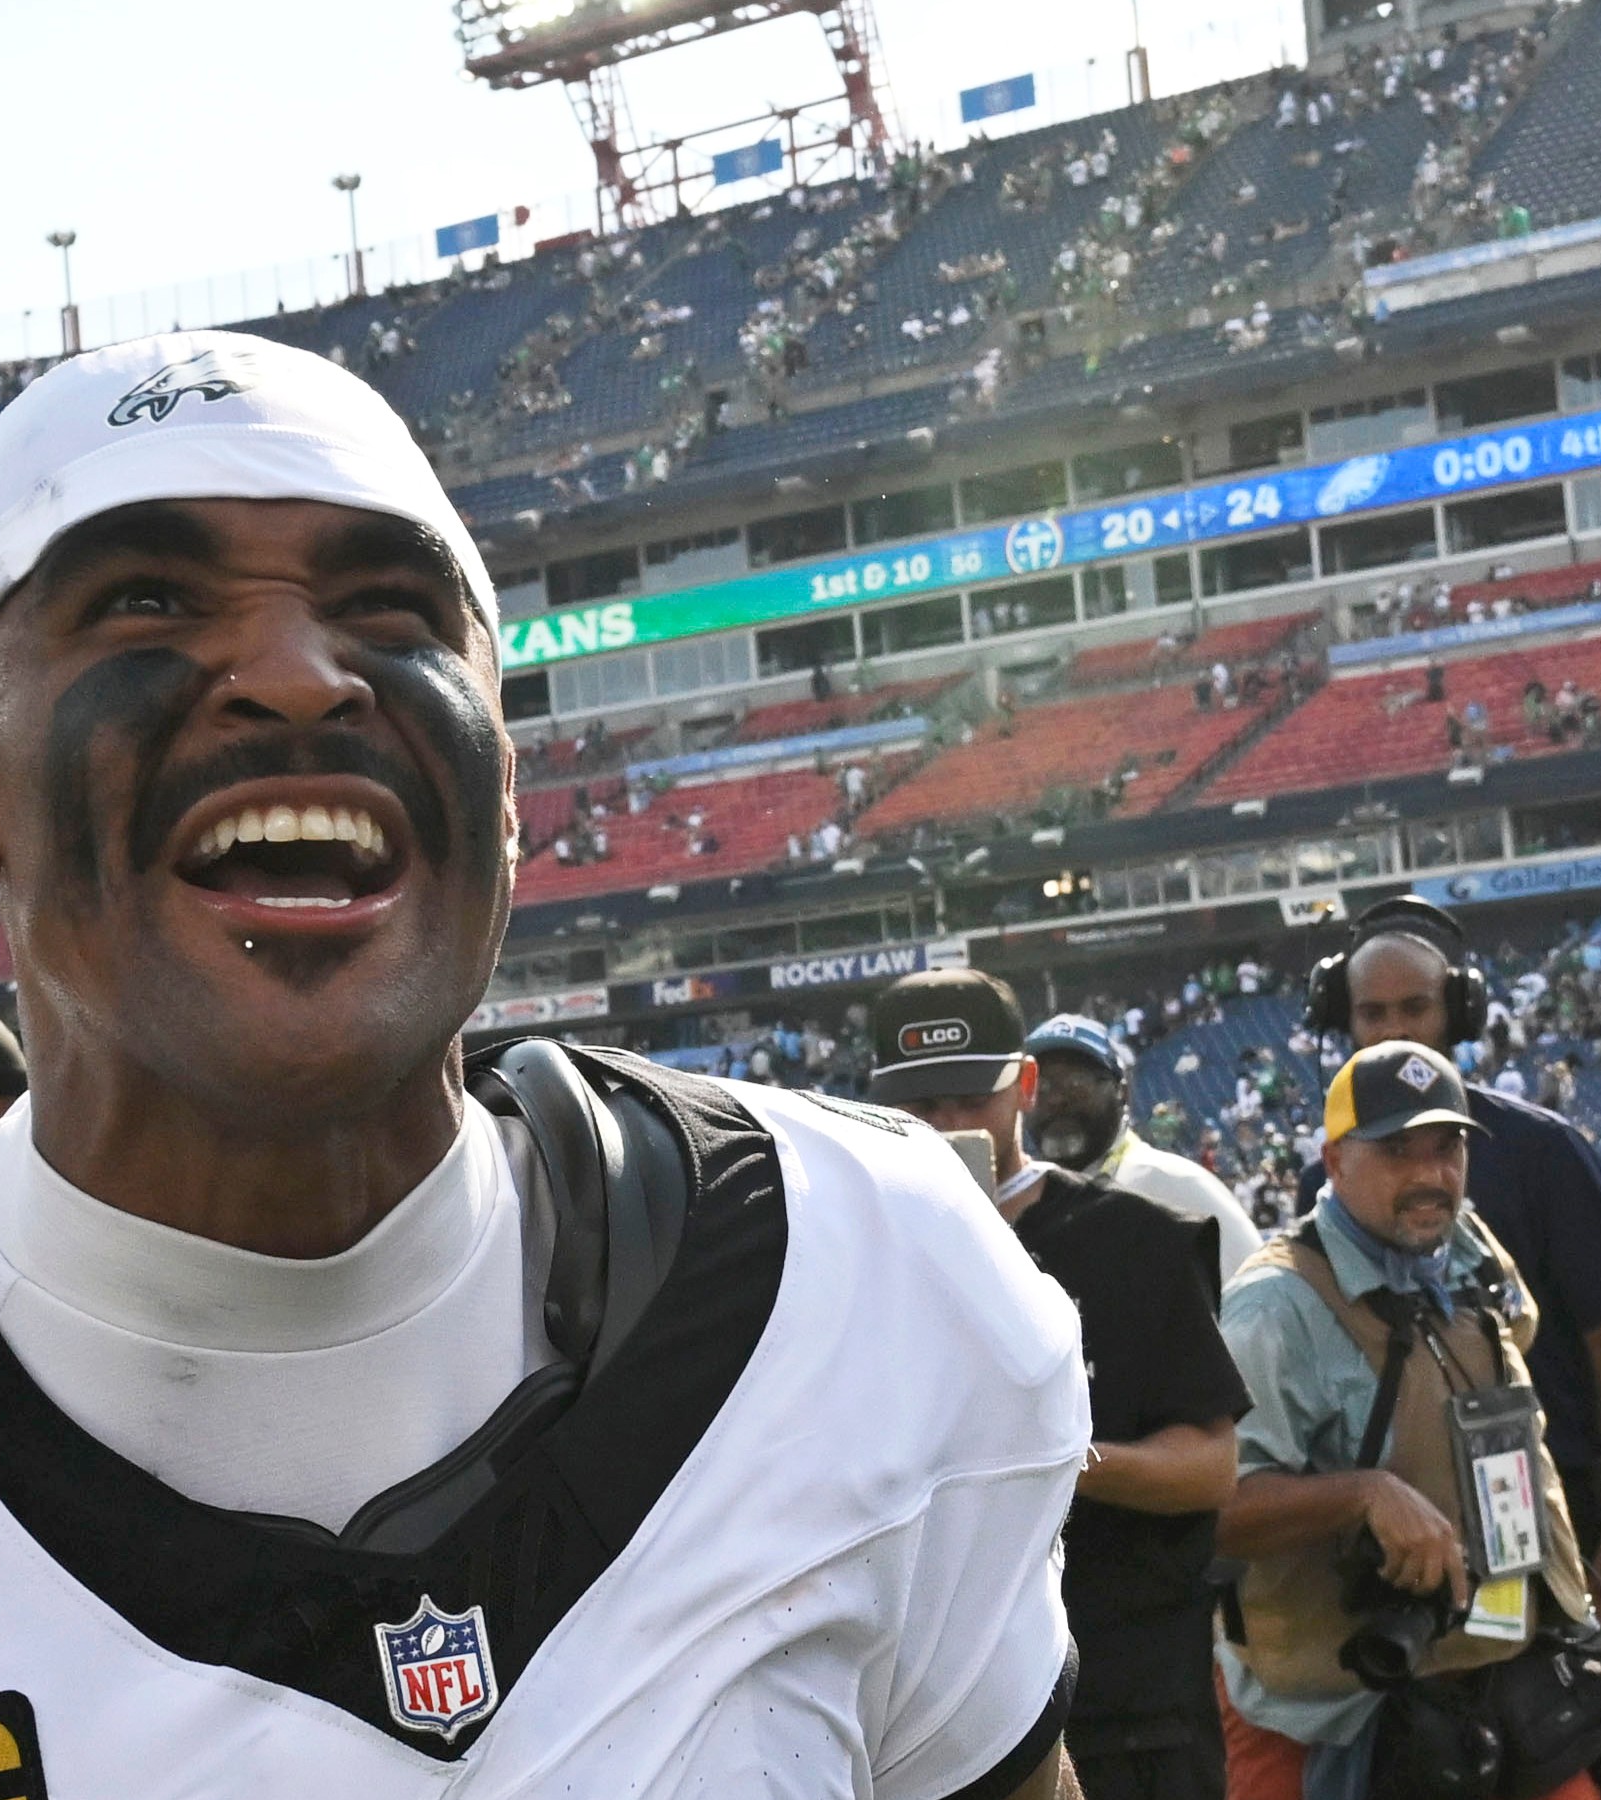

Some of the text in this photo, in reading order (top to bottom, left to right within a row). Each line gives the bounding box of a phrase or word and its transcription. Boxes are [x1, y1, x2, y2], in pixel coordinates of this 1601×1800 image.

[811, 572, 858, 602] 1st
[892, 553, 931, 584] 10
[1102, 510, 1154, 548] 20
[1225, 480, 1284, 529] 24
[1433, 434, 1532, 487] 0:00
[652, 980, 715, 1006] FedEx
[769, 950, 917, 989] ROCKY LAW
[402, 1658, 483, 1715] NFL
